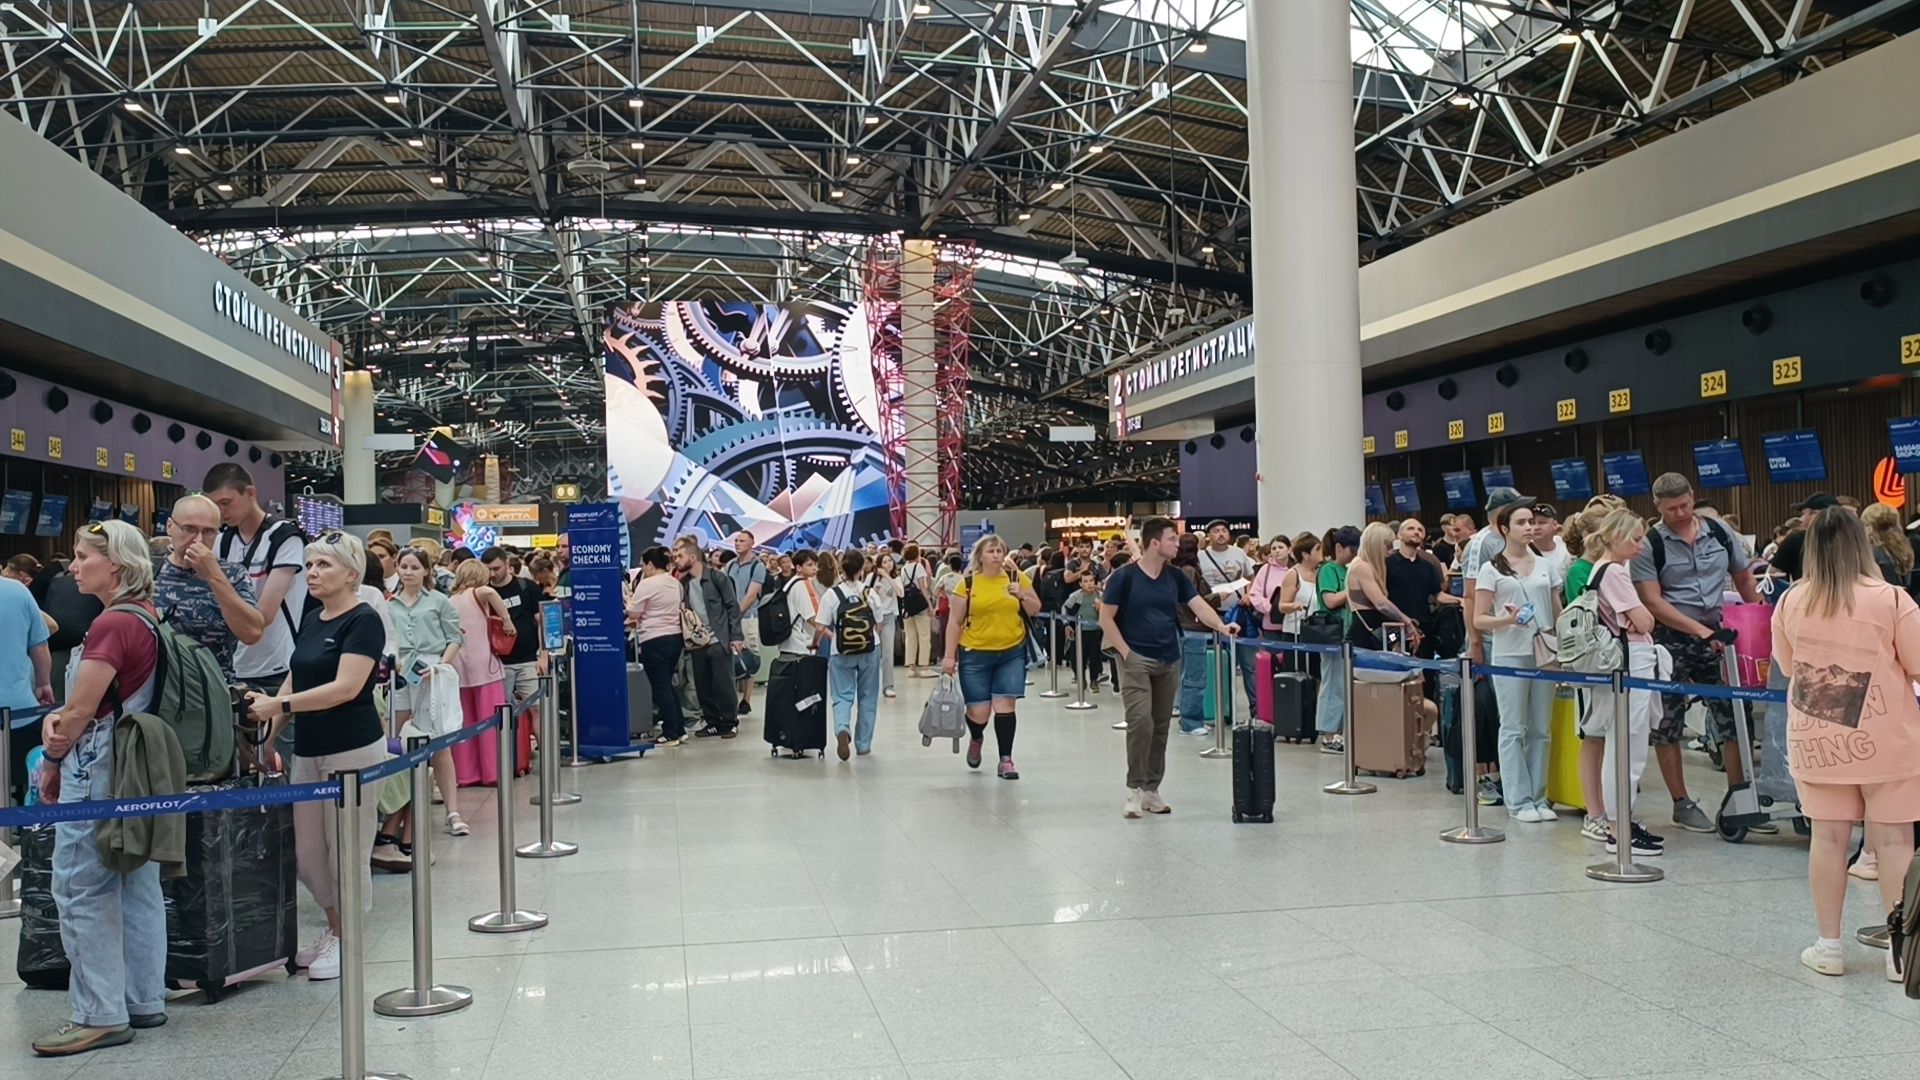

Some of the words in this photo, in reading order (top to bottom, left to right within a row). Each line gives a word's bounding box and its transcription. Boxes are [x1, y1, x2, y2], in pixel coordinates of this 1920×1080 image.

[214, 280, 264, 336] СТОЙКИ
[266, 313, 331, 375] РЕГИСТРАЦИИ
[333, 355, 341, 390] 3
[1125, 358, 1168, 396] СТОЙКИ
[1775, 361, 1798, 380] 325
[1114, 373, 1122, 406] 2
[1703, 375, 1724, 393] 324
[1611, 392, 1628, 408] 323
[1559, 402, 1574, 417] 322
[1450, 423, 1462, 436] 320
[1490, 416, 1502, 430] 321
[12, 431, 24, 447] 344
[49, 439, 61, 454] 345
[1229, 522, 1251, 531] point
[571, 544, 612, 554] ECONOMY
[572, 554, 611, 564] CHECK-IN
[574, 591, 586, 602] 40
[576, 617, 587, 627] 20
[577, 643, 589, 653] 10
[115, 800, 180, 813] AEROFLOT
